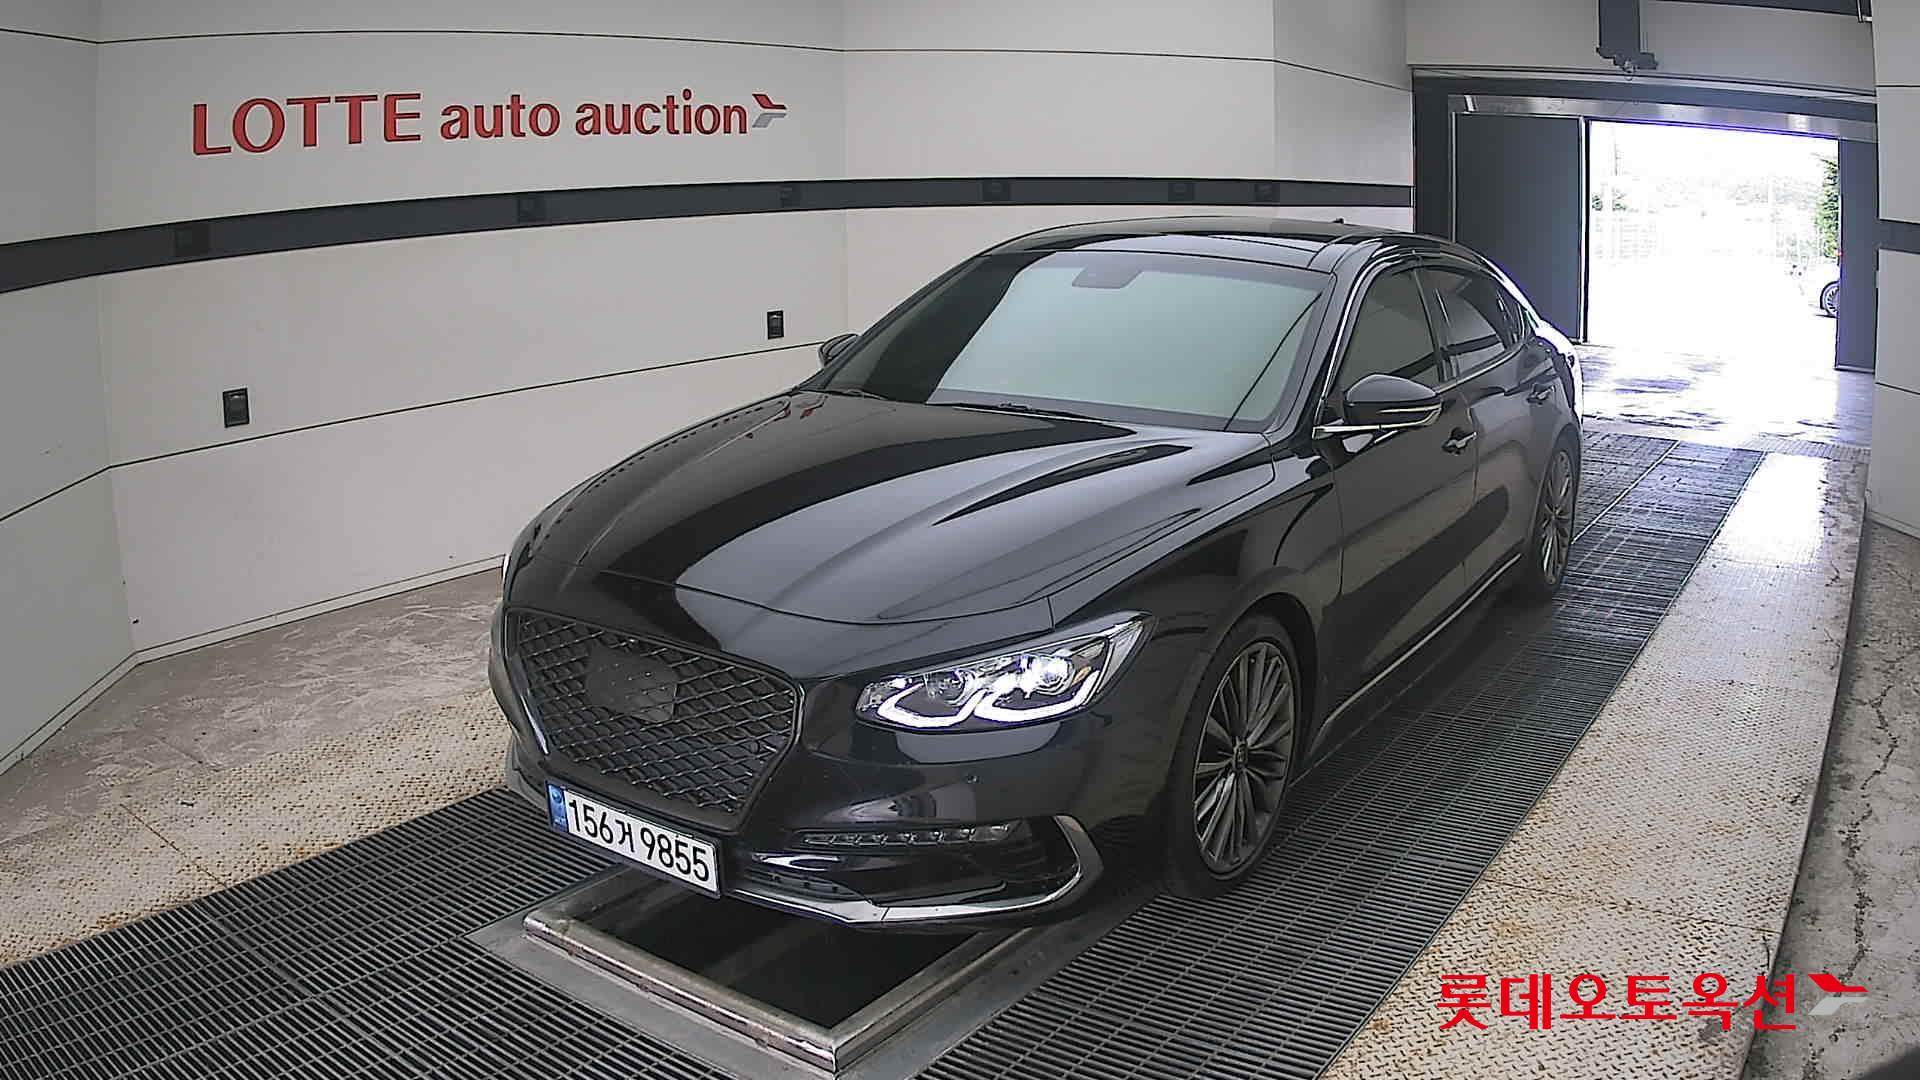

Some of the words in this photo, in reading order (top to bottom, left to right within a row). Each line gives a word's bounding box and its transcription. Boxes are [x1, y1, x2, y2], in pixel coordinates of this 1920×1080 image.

[192, 93, 421, 156] LOTTE
[440, 94, 561, 140] auto
[575, 88, 748, 136] auction
[568, 799, 636, 853] 156거
[640, 826, 710, 882] 9855
